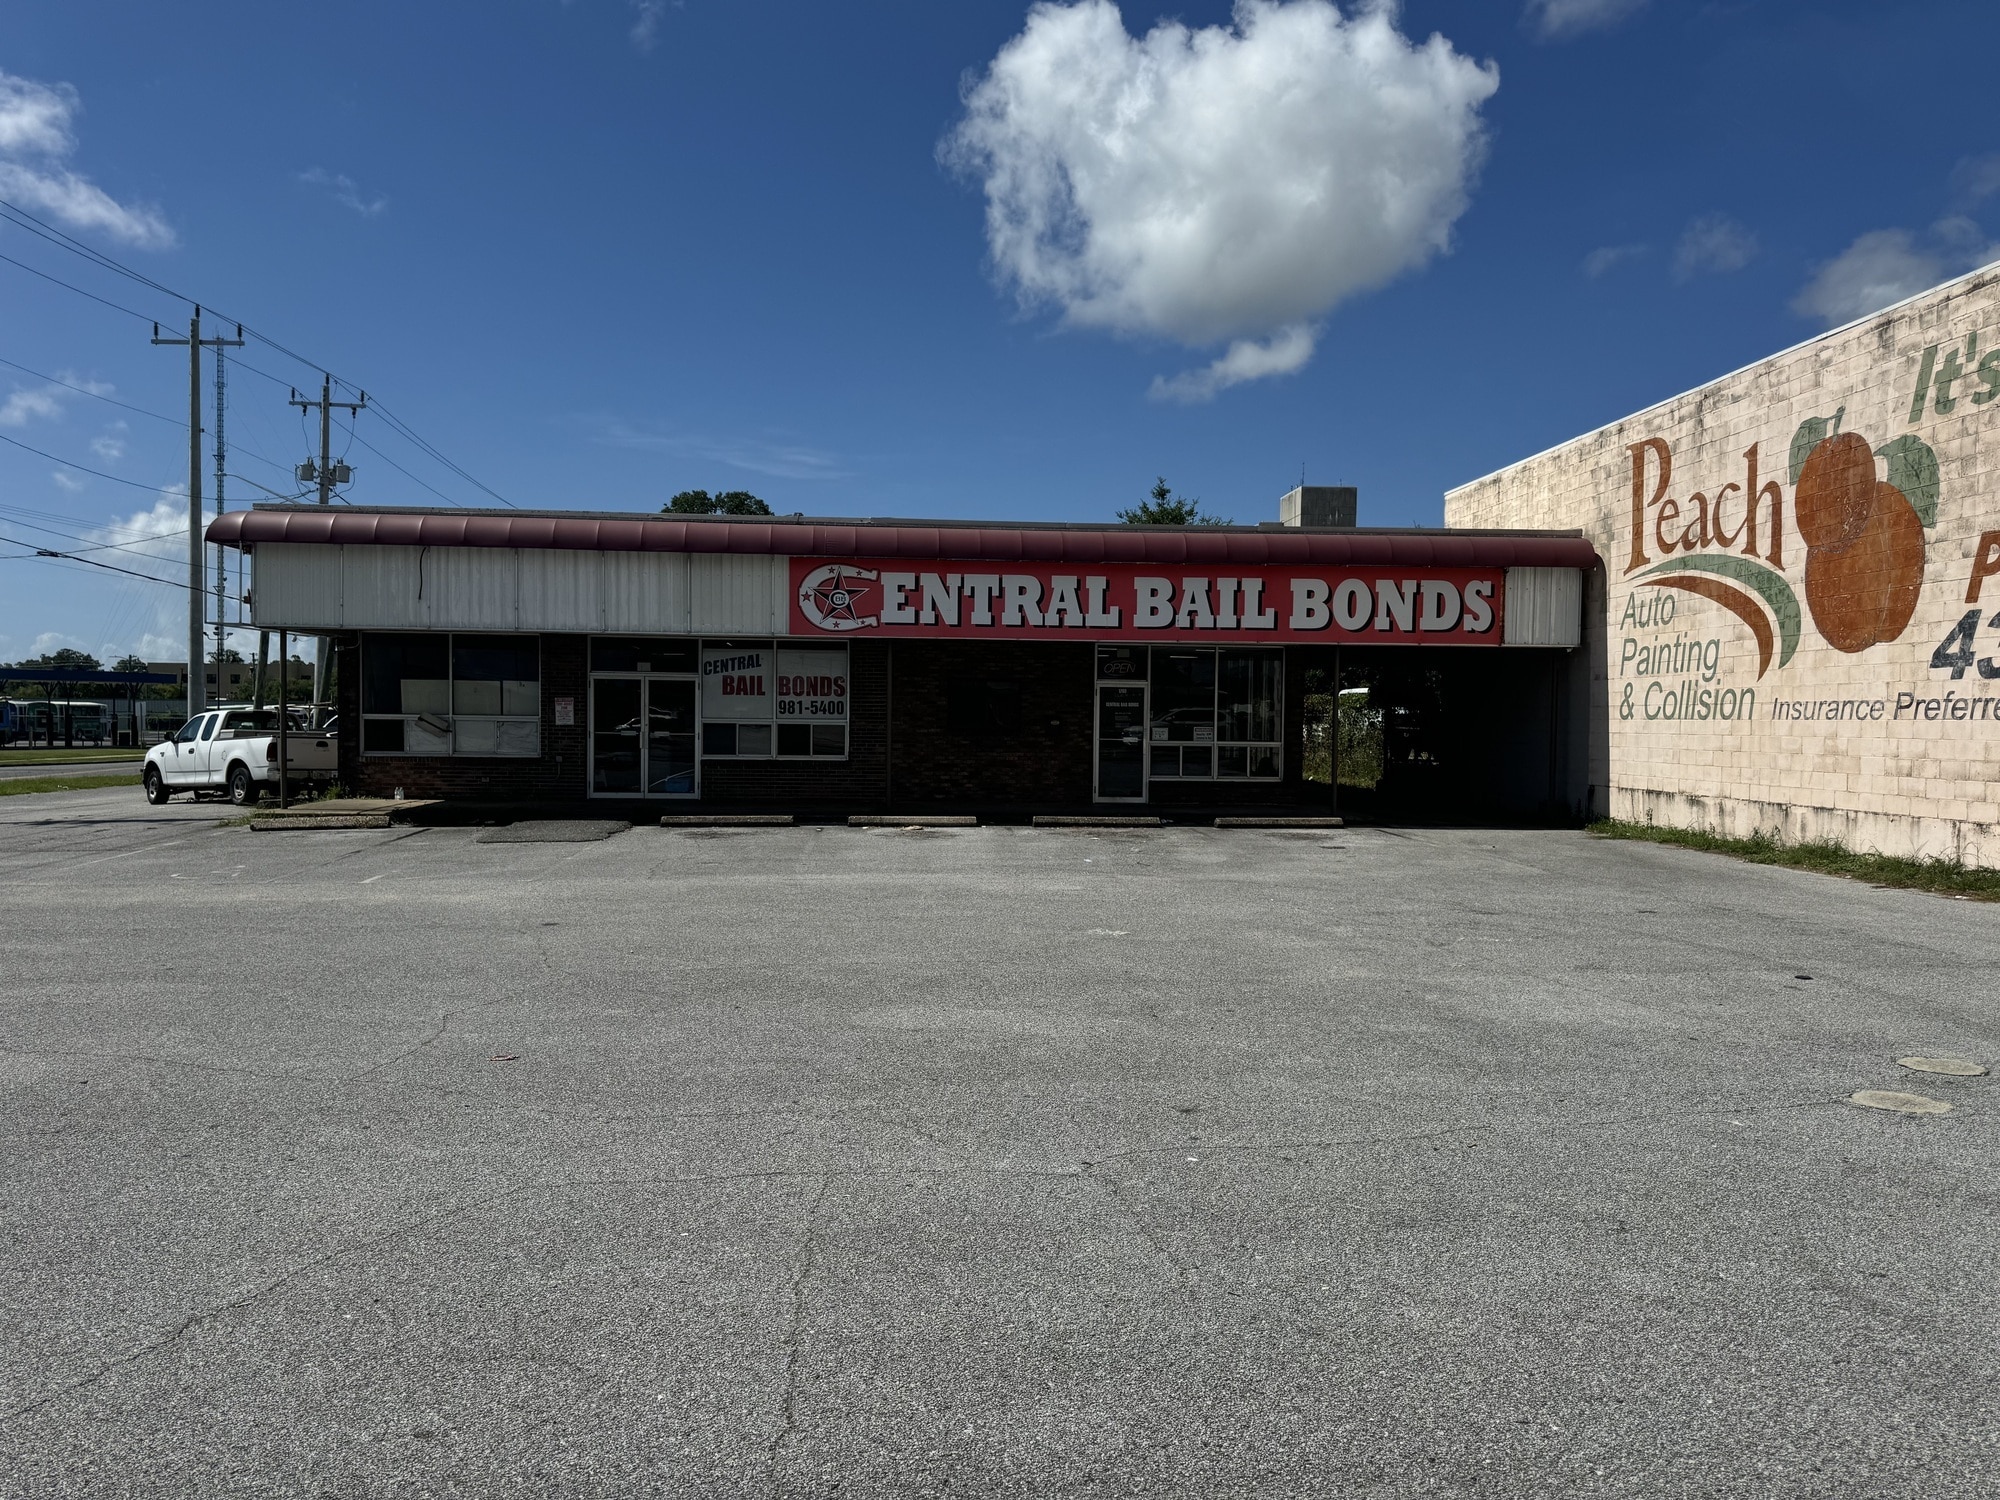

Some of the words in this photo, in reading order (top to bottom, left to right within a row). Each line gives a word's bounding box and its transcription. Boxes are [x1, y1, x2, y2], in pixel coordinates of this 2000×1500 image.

[1908, 331, 2000, 424] It's
[1623, 436, 1786, 577] Peach
[799, 563, 1121, 633] CENTRAL
[1133, 576, 1277, 630] BAIL
[1289, 578, 1494, 633] BONDS
[1620, 587, 1676, 631] Auto
[703, 653, 762, 676] CENTRAL
[1103, 662, 1137, 674] OPEN
[1620, 631, 1721, 682] Painting
[722, 674, 766, 696] BAIL
[778, 675, 846, 697] BONDS
[778, 699, 845, 715] 981-5400
[1619, 681, 1635, 721] &
[1644, 678, 1756, 721] Collision
[1771, 697, 1885, 721] Insurance
